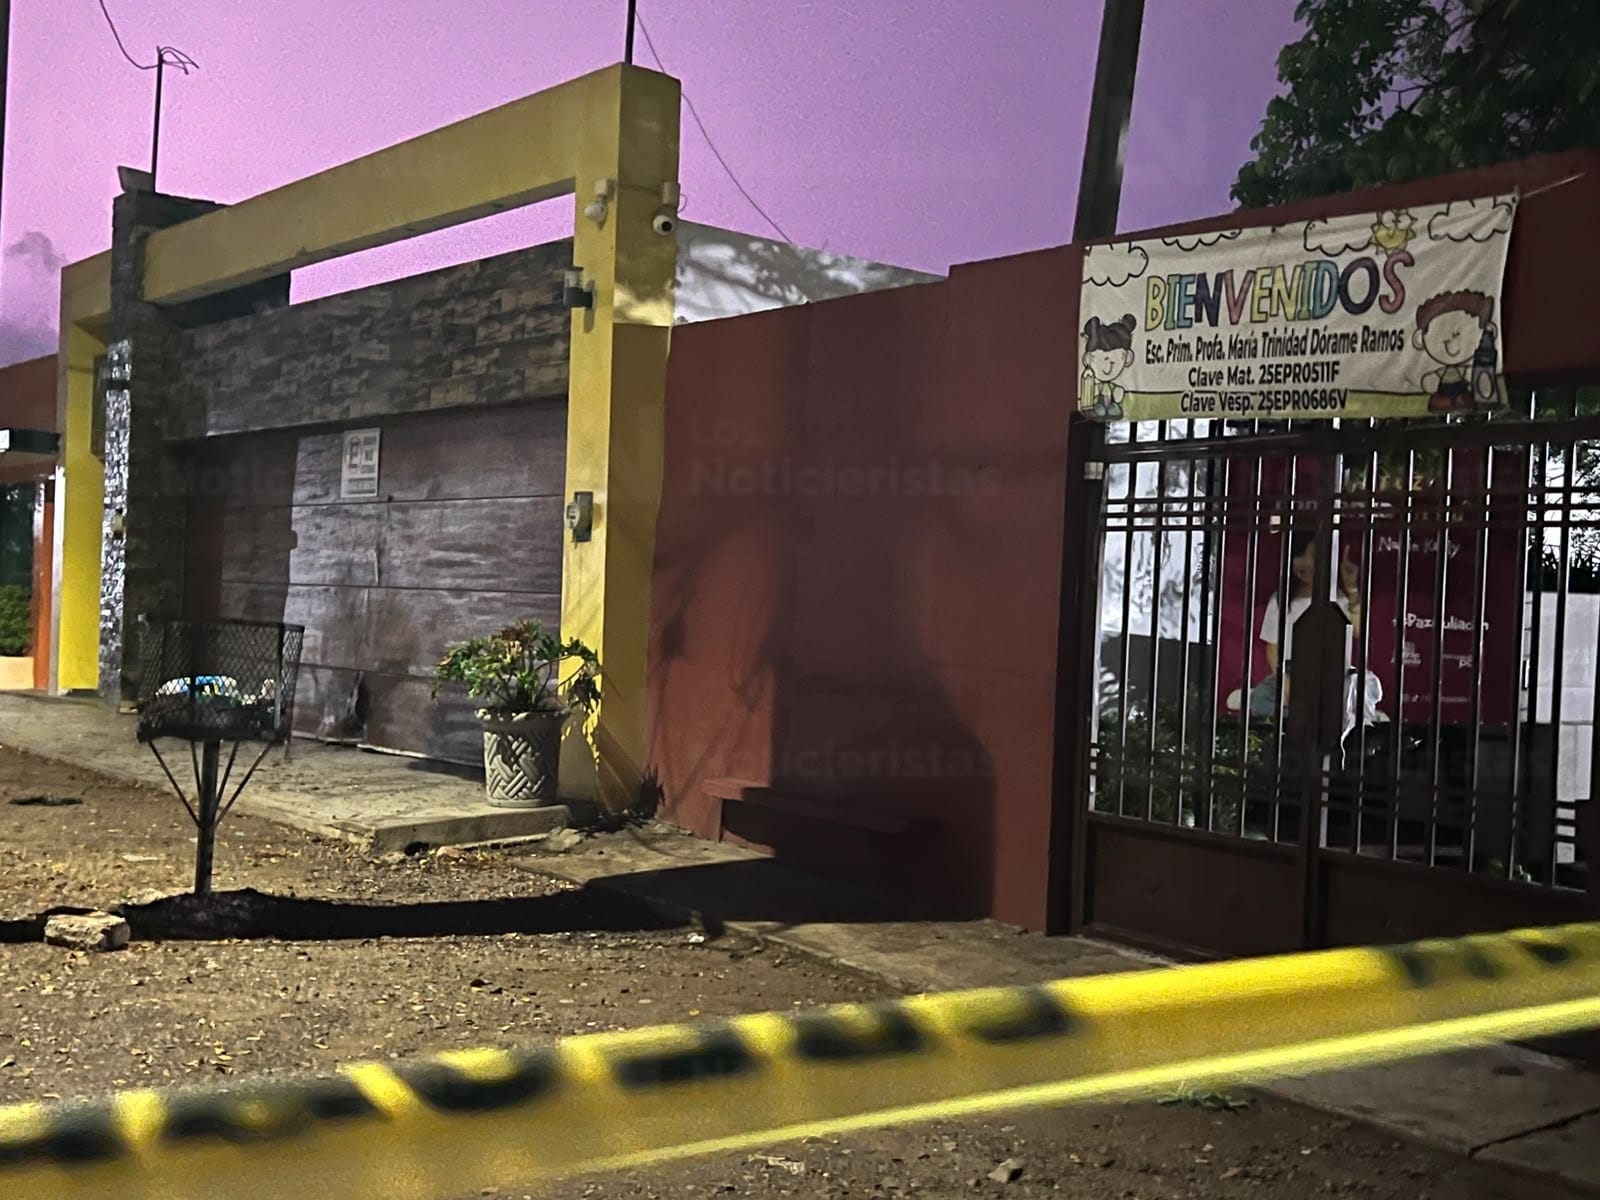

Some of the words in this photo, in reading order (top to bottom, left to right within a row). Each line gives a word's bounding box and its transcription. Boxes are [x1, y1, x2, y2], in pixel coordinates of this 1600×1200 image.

[1145, 250, 1415, 332] BIENVENIDOS
[1146, 339, 1164, 364] Esc.
[1167, 333, 1193, 363] Prim.
[1195, 332, 1226, 361] Profa.
[1228, 329, 1258, 360] María
[1261, 326, 1309, 358] Trinidad
[1310, 325, 1358, 355] Dórame
[1360, 324, 1404, 353] Ramos
[1188, 365, 1224, 387] Clave
[1227, 364, 1255, 386] Mat.
[1180, 391, 1216, 413] Clave
[1218, 390, 1254, 416] Vesp.
